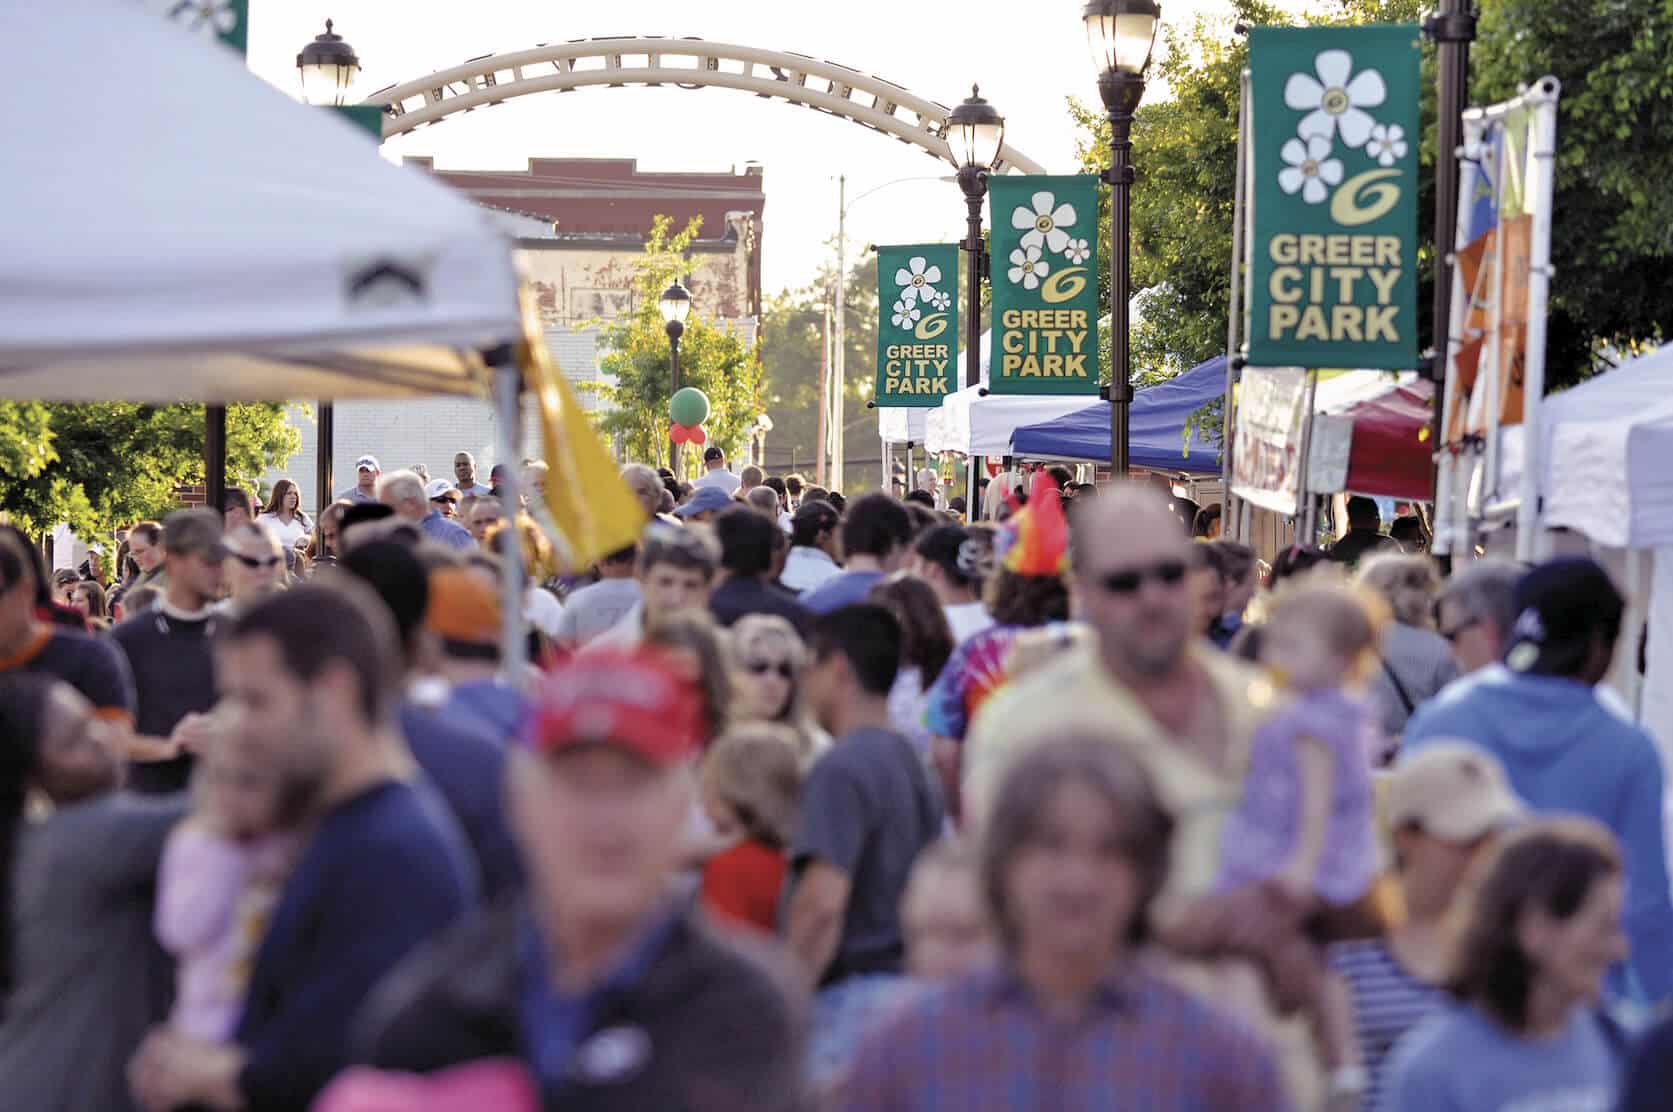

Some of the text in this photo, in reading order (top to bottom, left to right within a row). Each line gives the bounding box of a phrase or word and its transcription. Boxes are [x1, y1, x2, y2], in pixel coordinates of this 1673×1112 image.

[1269, 234, 1401, 266] GREER
[1269, 267, 1401, 305] CITY
[1002, 309, 1088, 329] GREER
[1269, 305, 1400, 342] PARK
[886, 344, 949, 359] GREER
[1002, 330, 1088, 354] CITY
[886, 359, 949, 377] CITY
[1002, 354, 1088, 377] PARK
[885, 377, 948, 394] PARK
